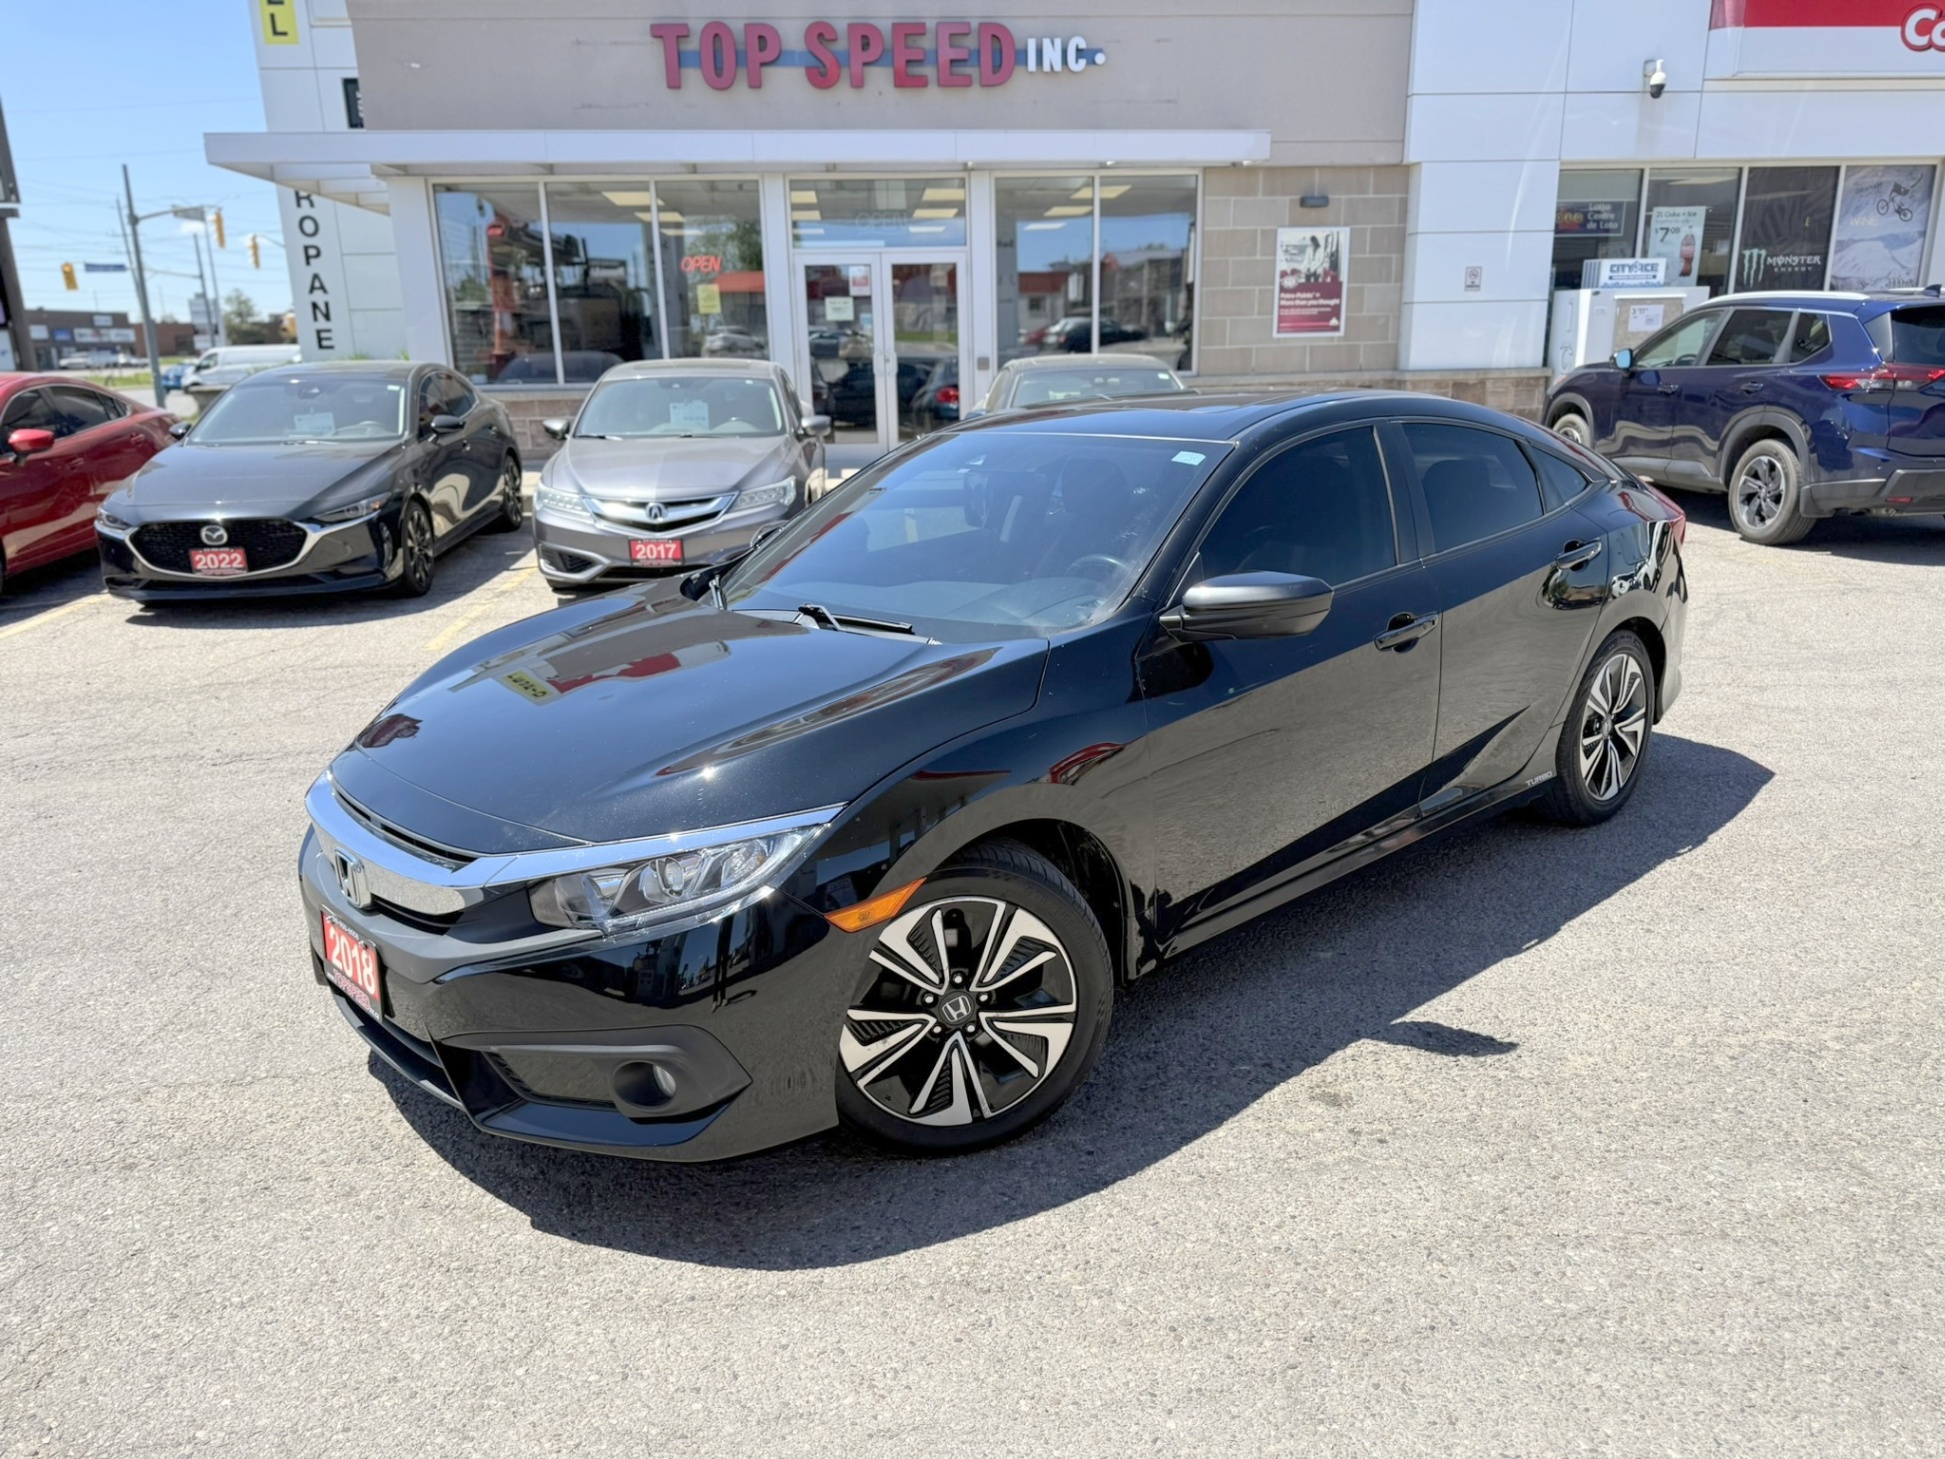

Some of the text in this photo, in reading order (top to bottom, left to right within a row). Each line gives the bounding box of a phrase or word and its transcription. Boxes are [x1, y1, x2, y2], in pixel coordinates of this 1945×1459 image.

[650, 21, 1106, 90] TOP SPEED INC.
[1587, 212, 1616, 220] Centre
[680, 255, 722, 272] OPEN
[1609, 262, 1659, 274] CITY ICE
[1766, 254, 1821, 267] MONSTER
[635, 543, 677, 559] 2017
[195, 553, 244, 570] 2022
[1525, 771, 1553, 786] TURBO
[329, 926, 376, 996] 2018
